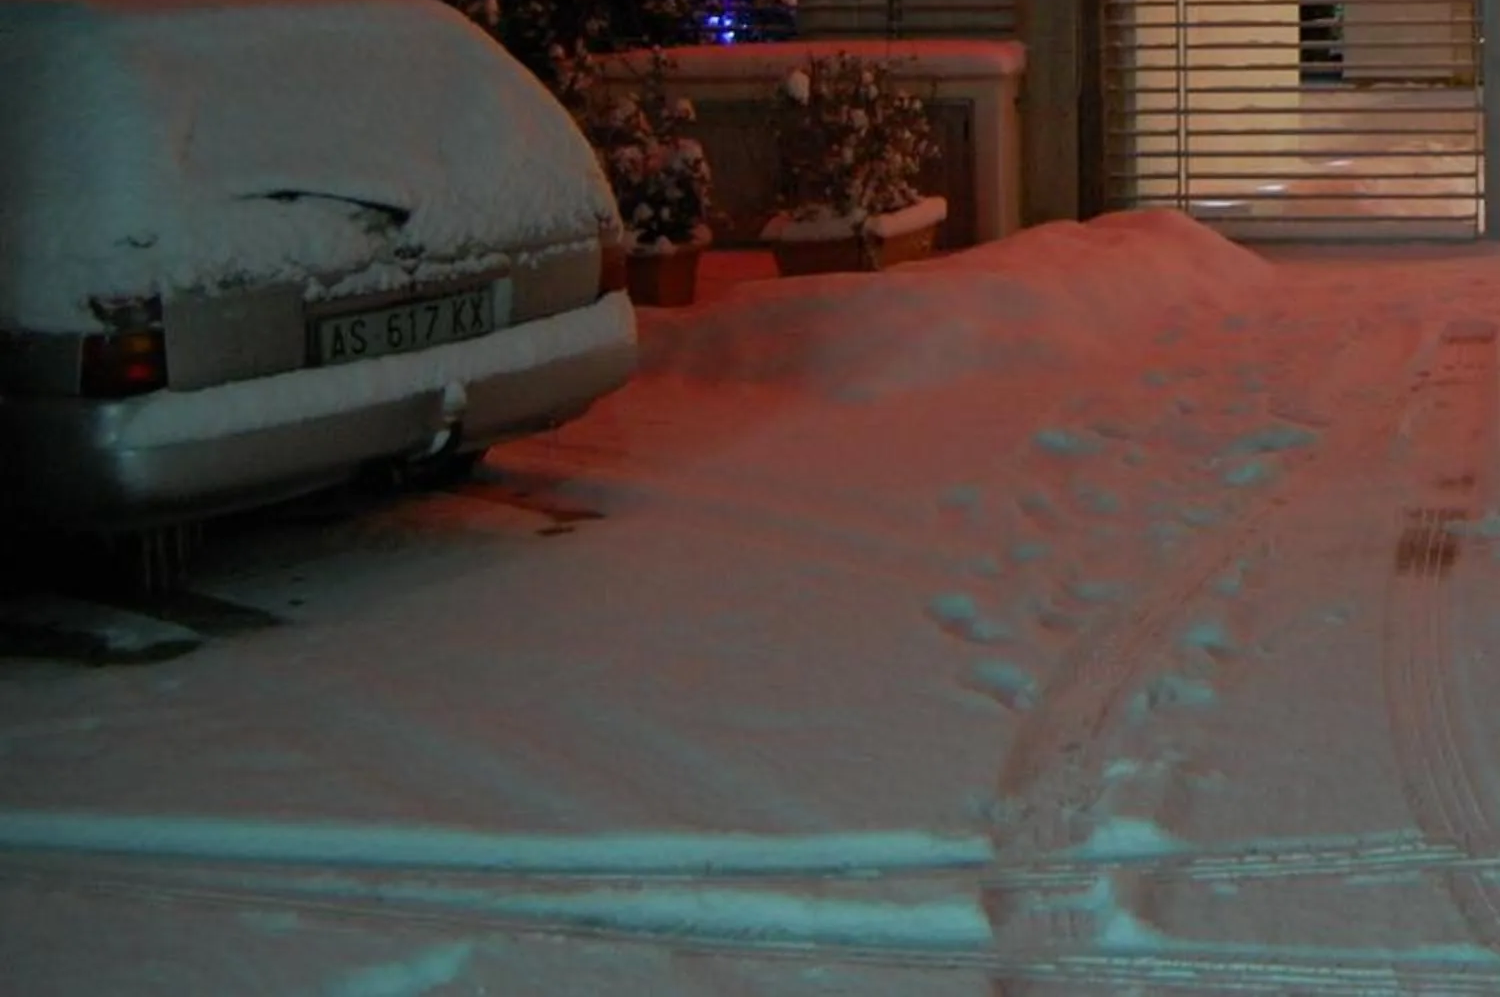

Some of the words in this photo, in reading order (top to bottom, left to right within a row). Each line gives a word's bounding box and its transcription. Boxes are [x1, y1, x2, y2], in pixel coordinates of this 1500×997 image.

[331, 318, 369, 359] AS
[386, 305, 441, 349] 617
[452, 294, 484, 336] KX
